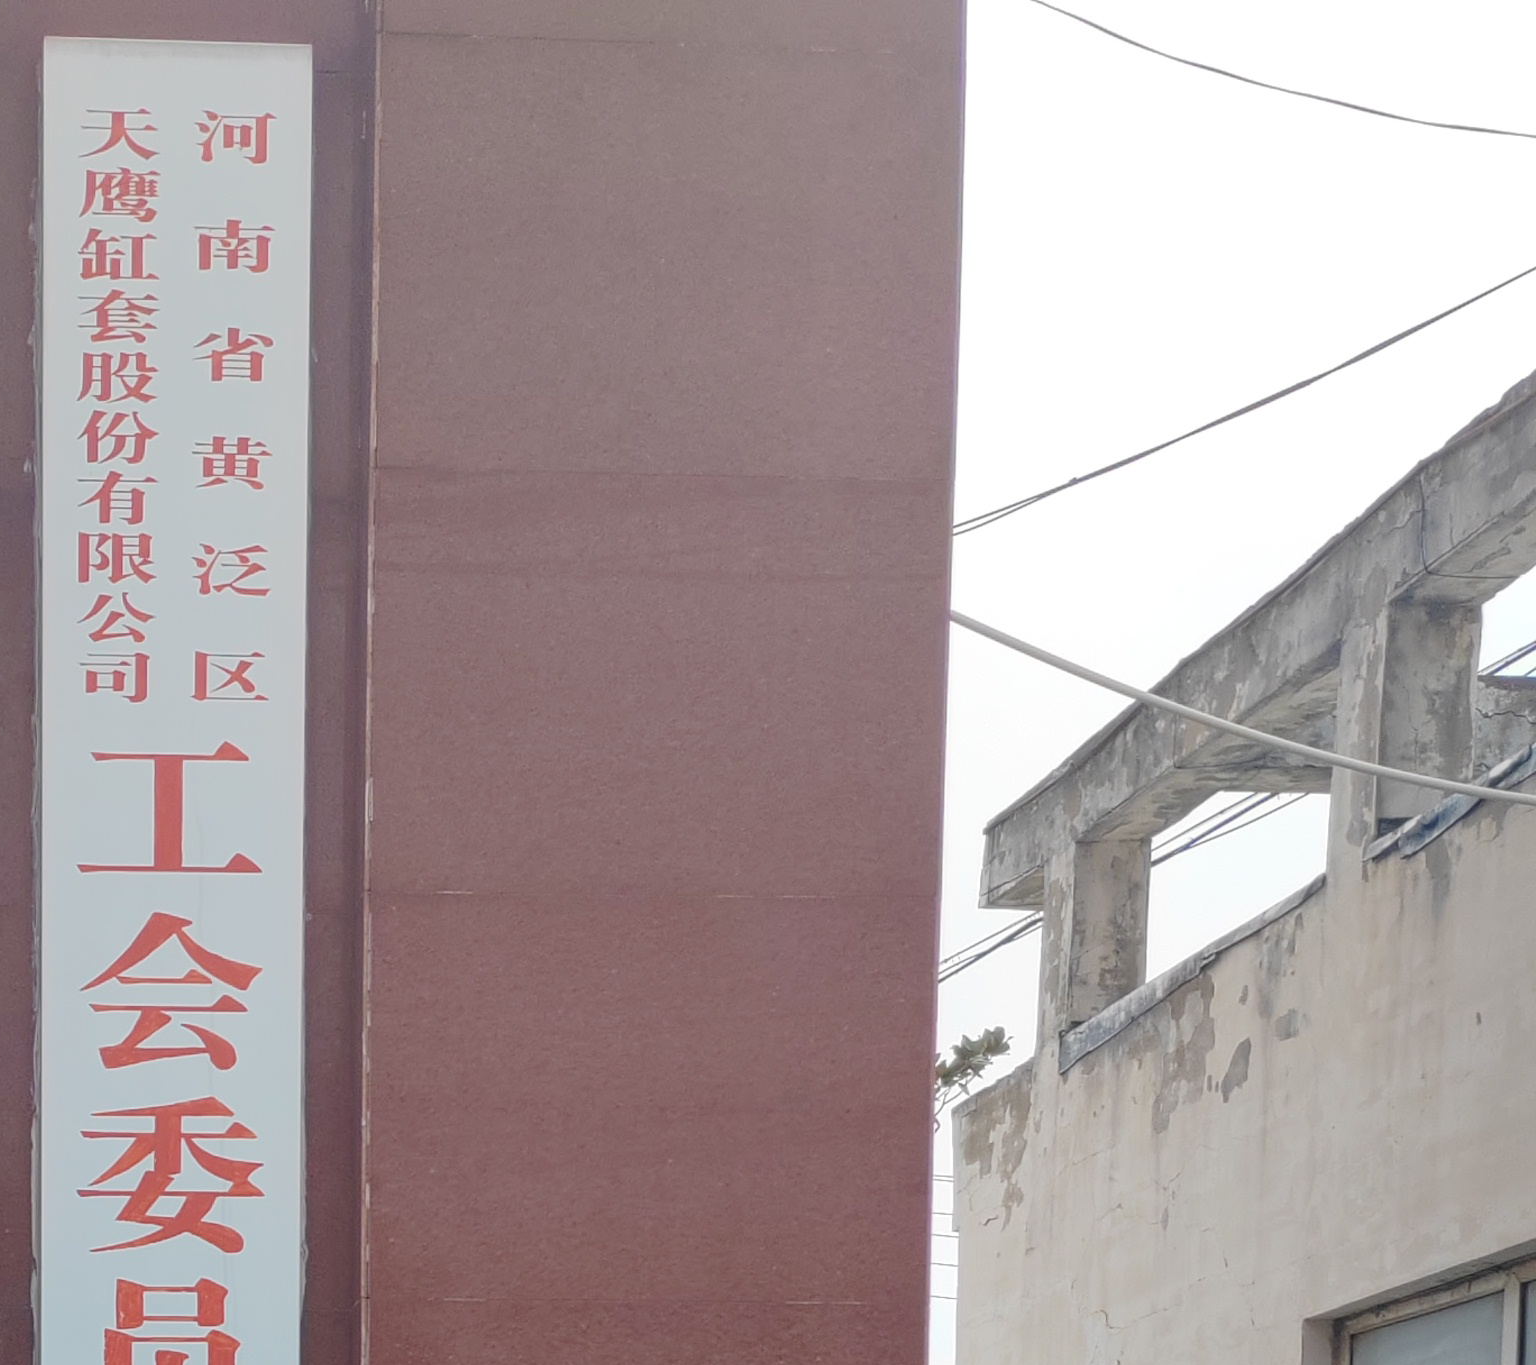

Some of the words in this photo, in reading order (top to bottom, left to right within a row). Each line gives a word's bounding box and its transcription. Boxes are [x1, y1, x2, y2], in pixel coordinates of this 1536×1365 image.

[78, 108, 160, 704] 天鹰缸套股份有限公司
[191, 111, 275, 703] 河南省黄泛区
